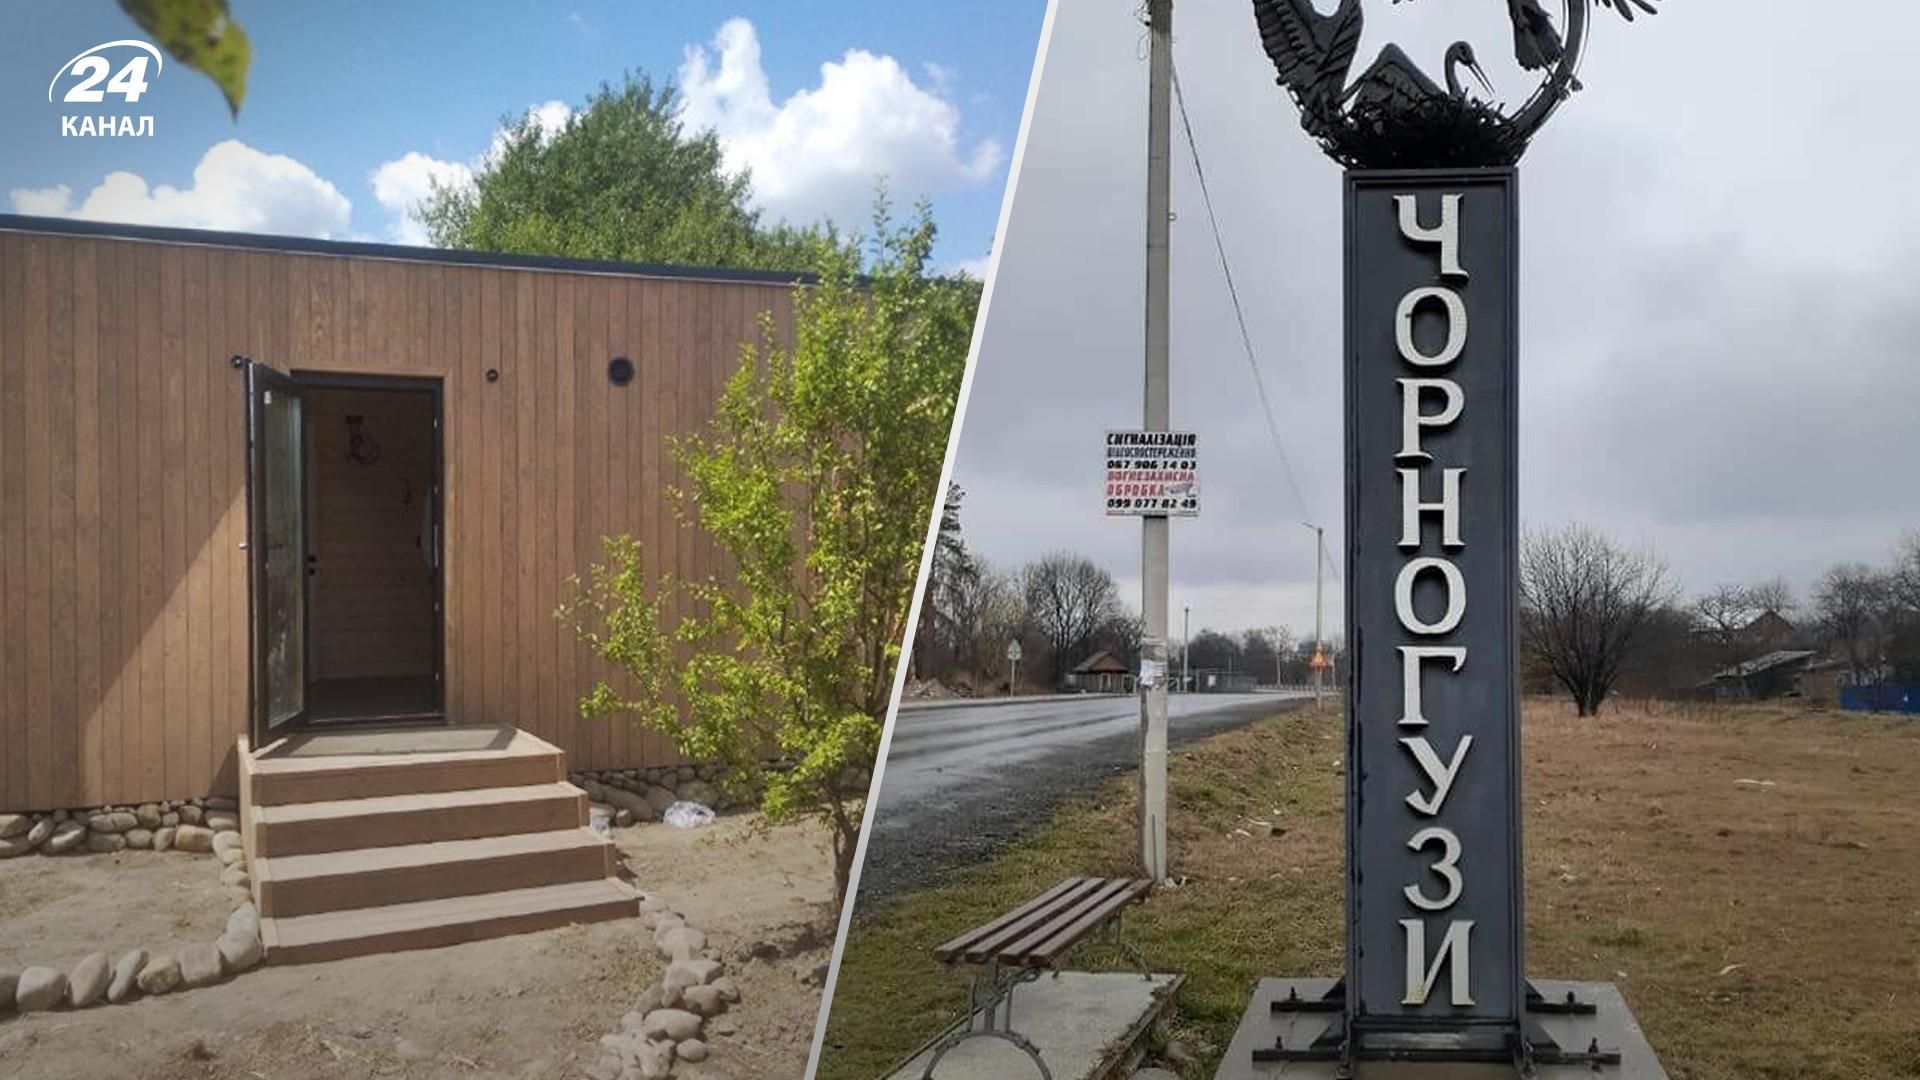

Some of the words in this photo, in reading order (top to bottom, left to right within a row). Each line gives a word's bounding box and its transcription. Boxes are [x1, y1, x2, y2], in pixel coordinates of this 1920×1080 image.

[1107, 433, 1197, 447] СИГНАЛІЗАЦІЯ
[1107, 460, 1131, 470] 067
[1162, 460, 1178, 470] 14
[1107, 484, 1165, 497] ОБРОБКА
[1107, 498, 1131, 509] 099
[1134, 498, 1158, 509] 077
[1181, 498, 1197, 509] 49
[1392, 193, 1475, 1006] ЧОРНОГУЗИ
